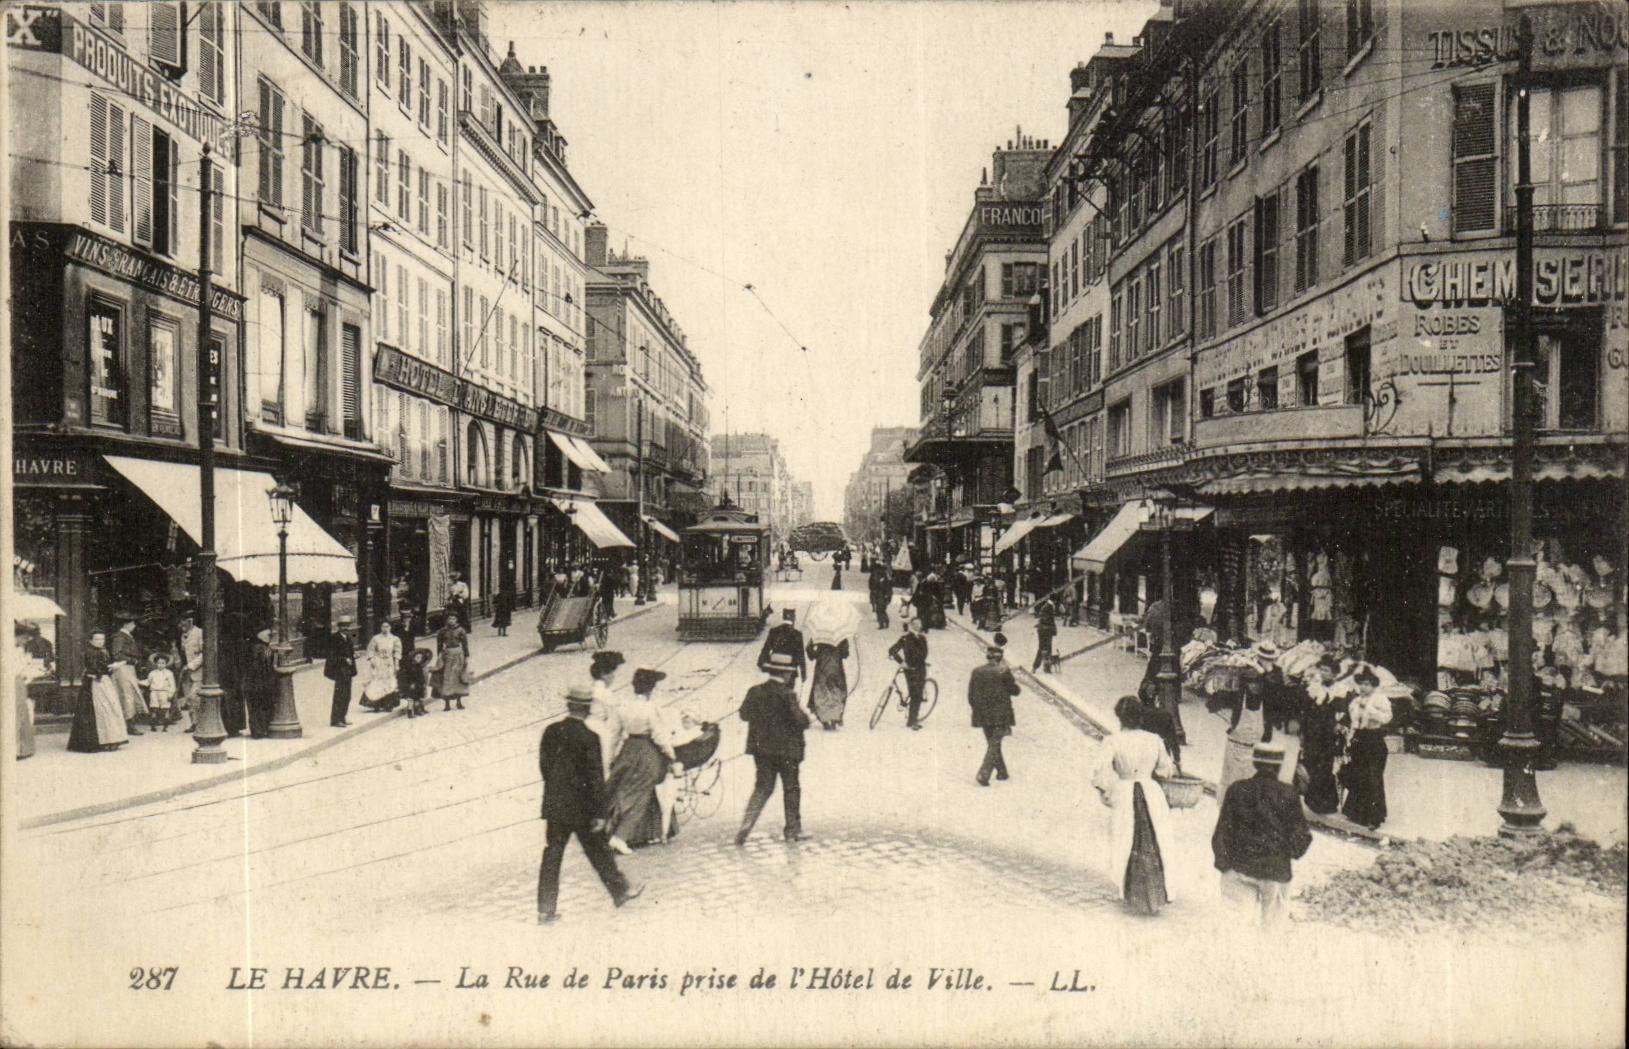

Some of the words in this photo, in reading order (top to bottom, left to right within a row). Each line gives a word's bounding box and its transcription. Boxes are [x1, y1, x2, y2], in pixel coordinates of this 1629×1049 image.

[73, 21, 154, 107] PRODUITS
[74, 235, 109, 265] VINS
[178, 276, 240, 316] ETRGERS
[1409, 254, 1627, 309] CHEMSERI
[1414, 314, 1480, 337] ROBES
[1440, 339, 1459, 350] ET
[400, 356, 443, 398] HOTEL
[15, 459, 77, 475] HAVRE
